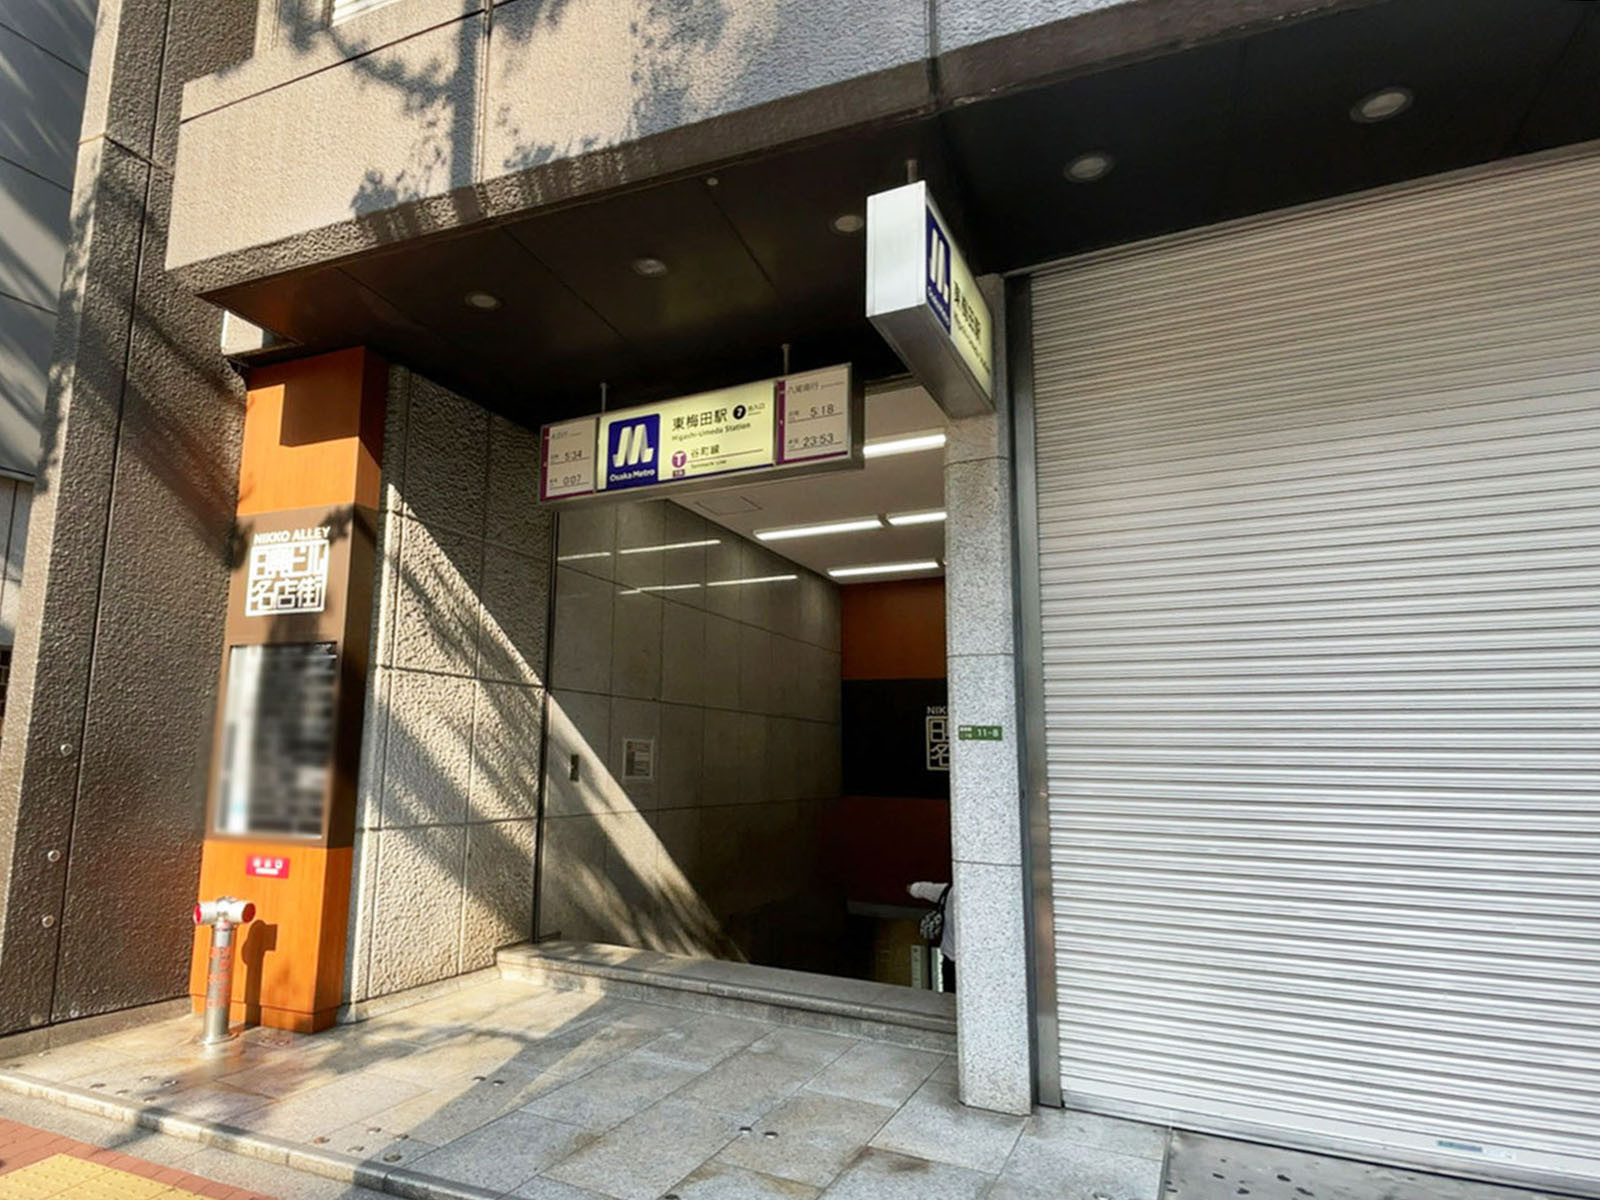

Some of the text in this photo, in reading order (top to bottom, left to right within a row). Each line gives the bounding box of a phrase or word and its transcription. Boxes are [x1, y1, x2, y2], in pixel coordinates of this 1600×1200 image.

[672, 408, 727, 431] 東梅田駅
[725, 423, 751, 432] Station
[609, 469, 656, 482] Osaka Metro
[253, 526, 331, 545] NIKKO ALLEY
